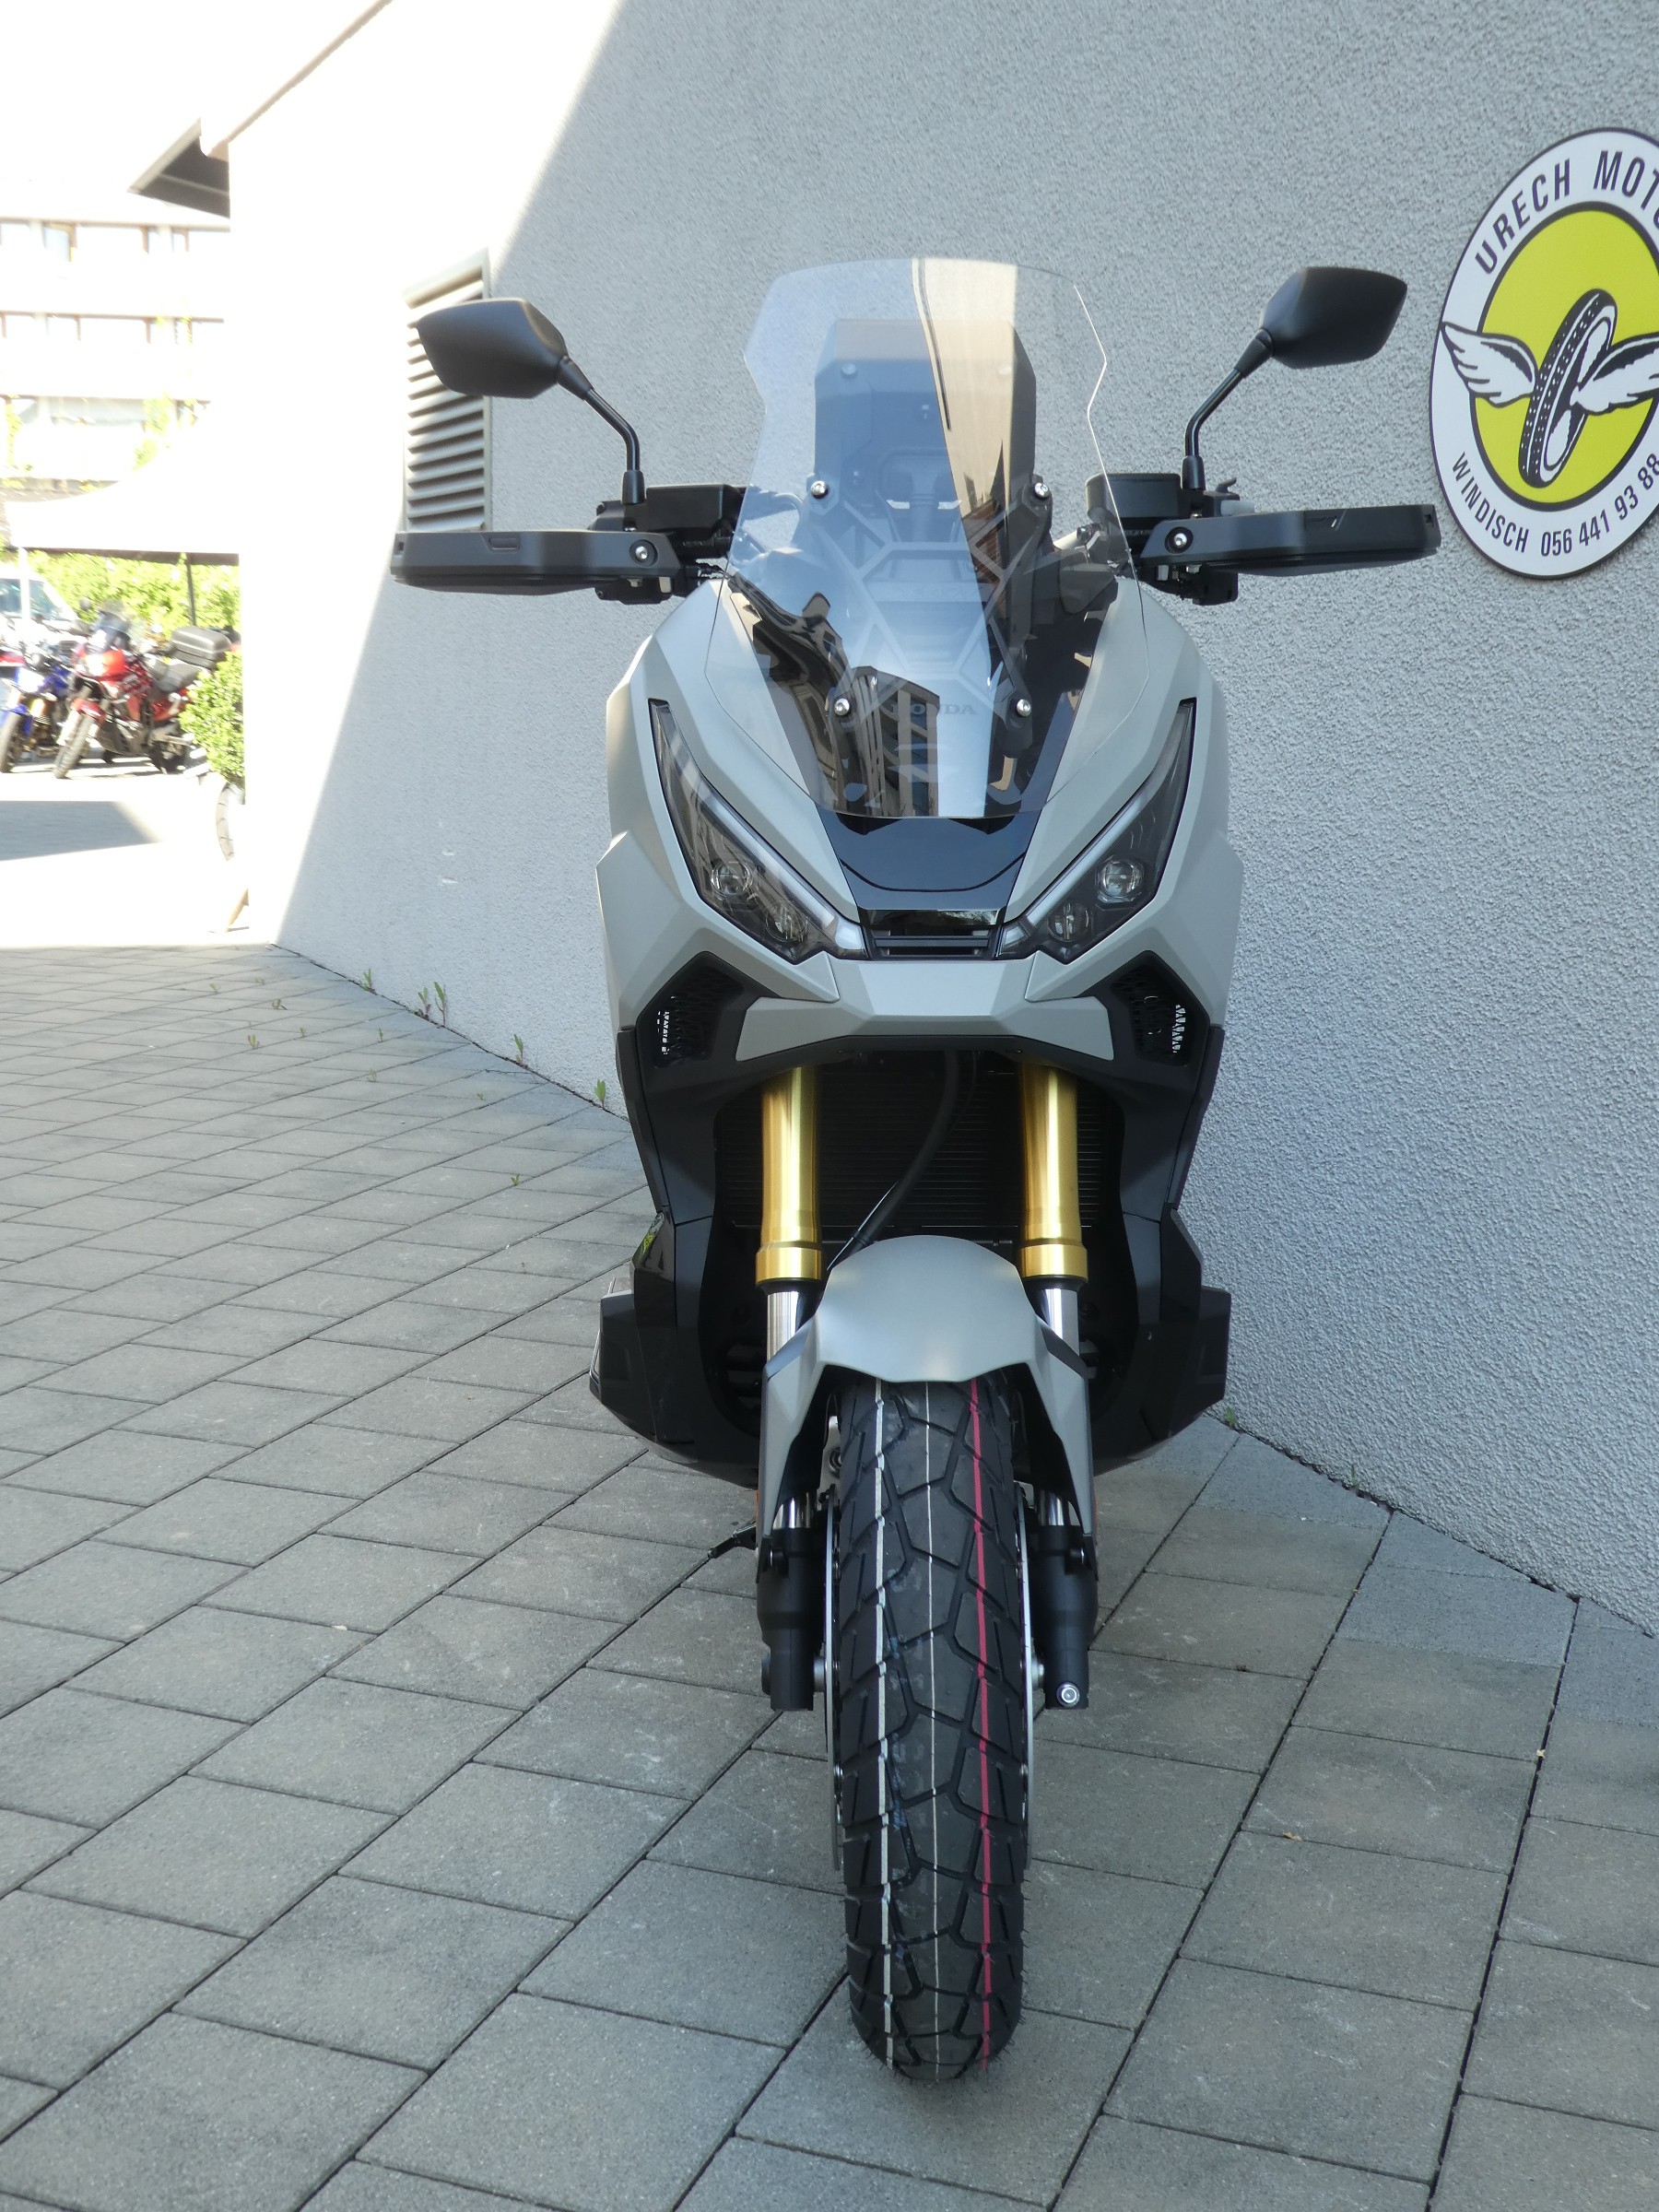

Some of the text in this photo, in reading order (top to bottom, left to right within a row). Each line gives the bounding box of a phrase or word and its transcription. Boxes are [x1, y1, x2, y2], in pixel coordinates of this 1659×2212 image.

[1475, 158, 1571, 275] URECH
[1452, 451, 1659, 557] WINDISCH 056 441 93 88
